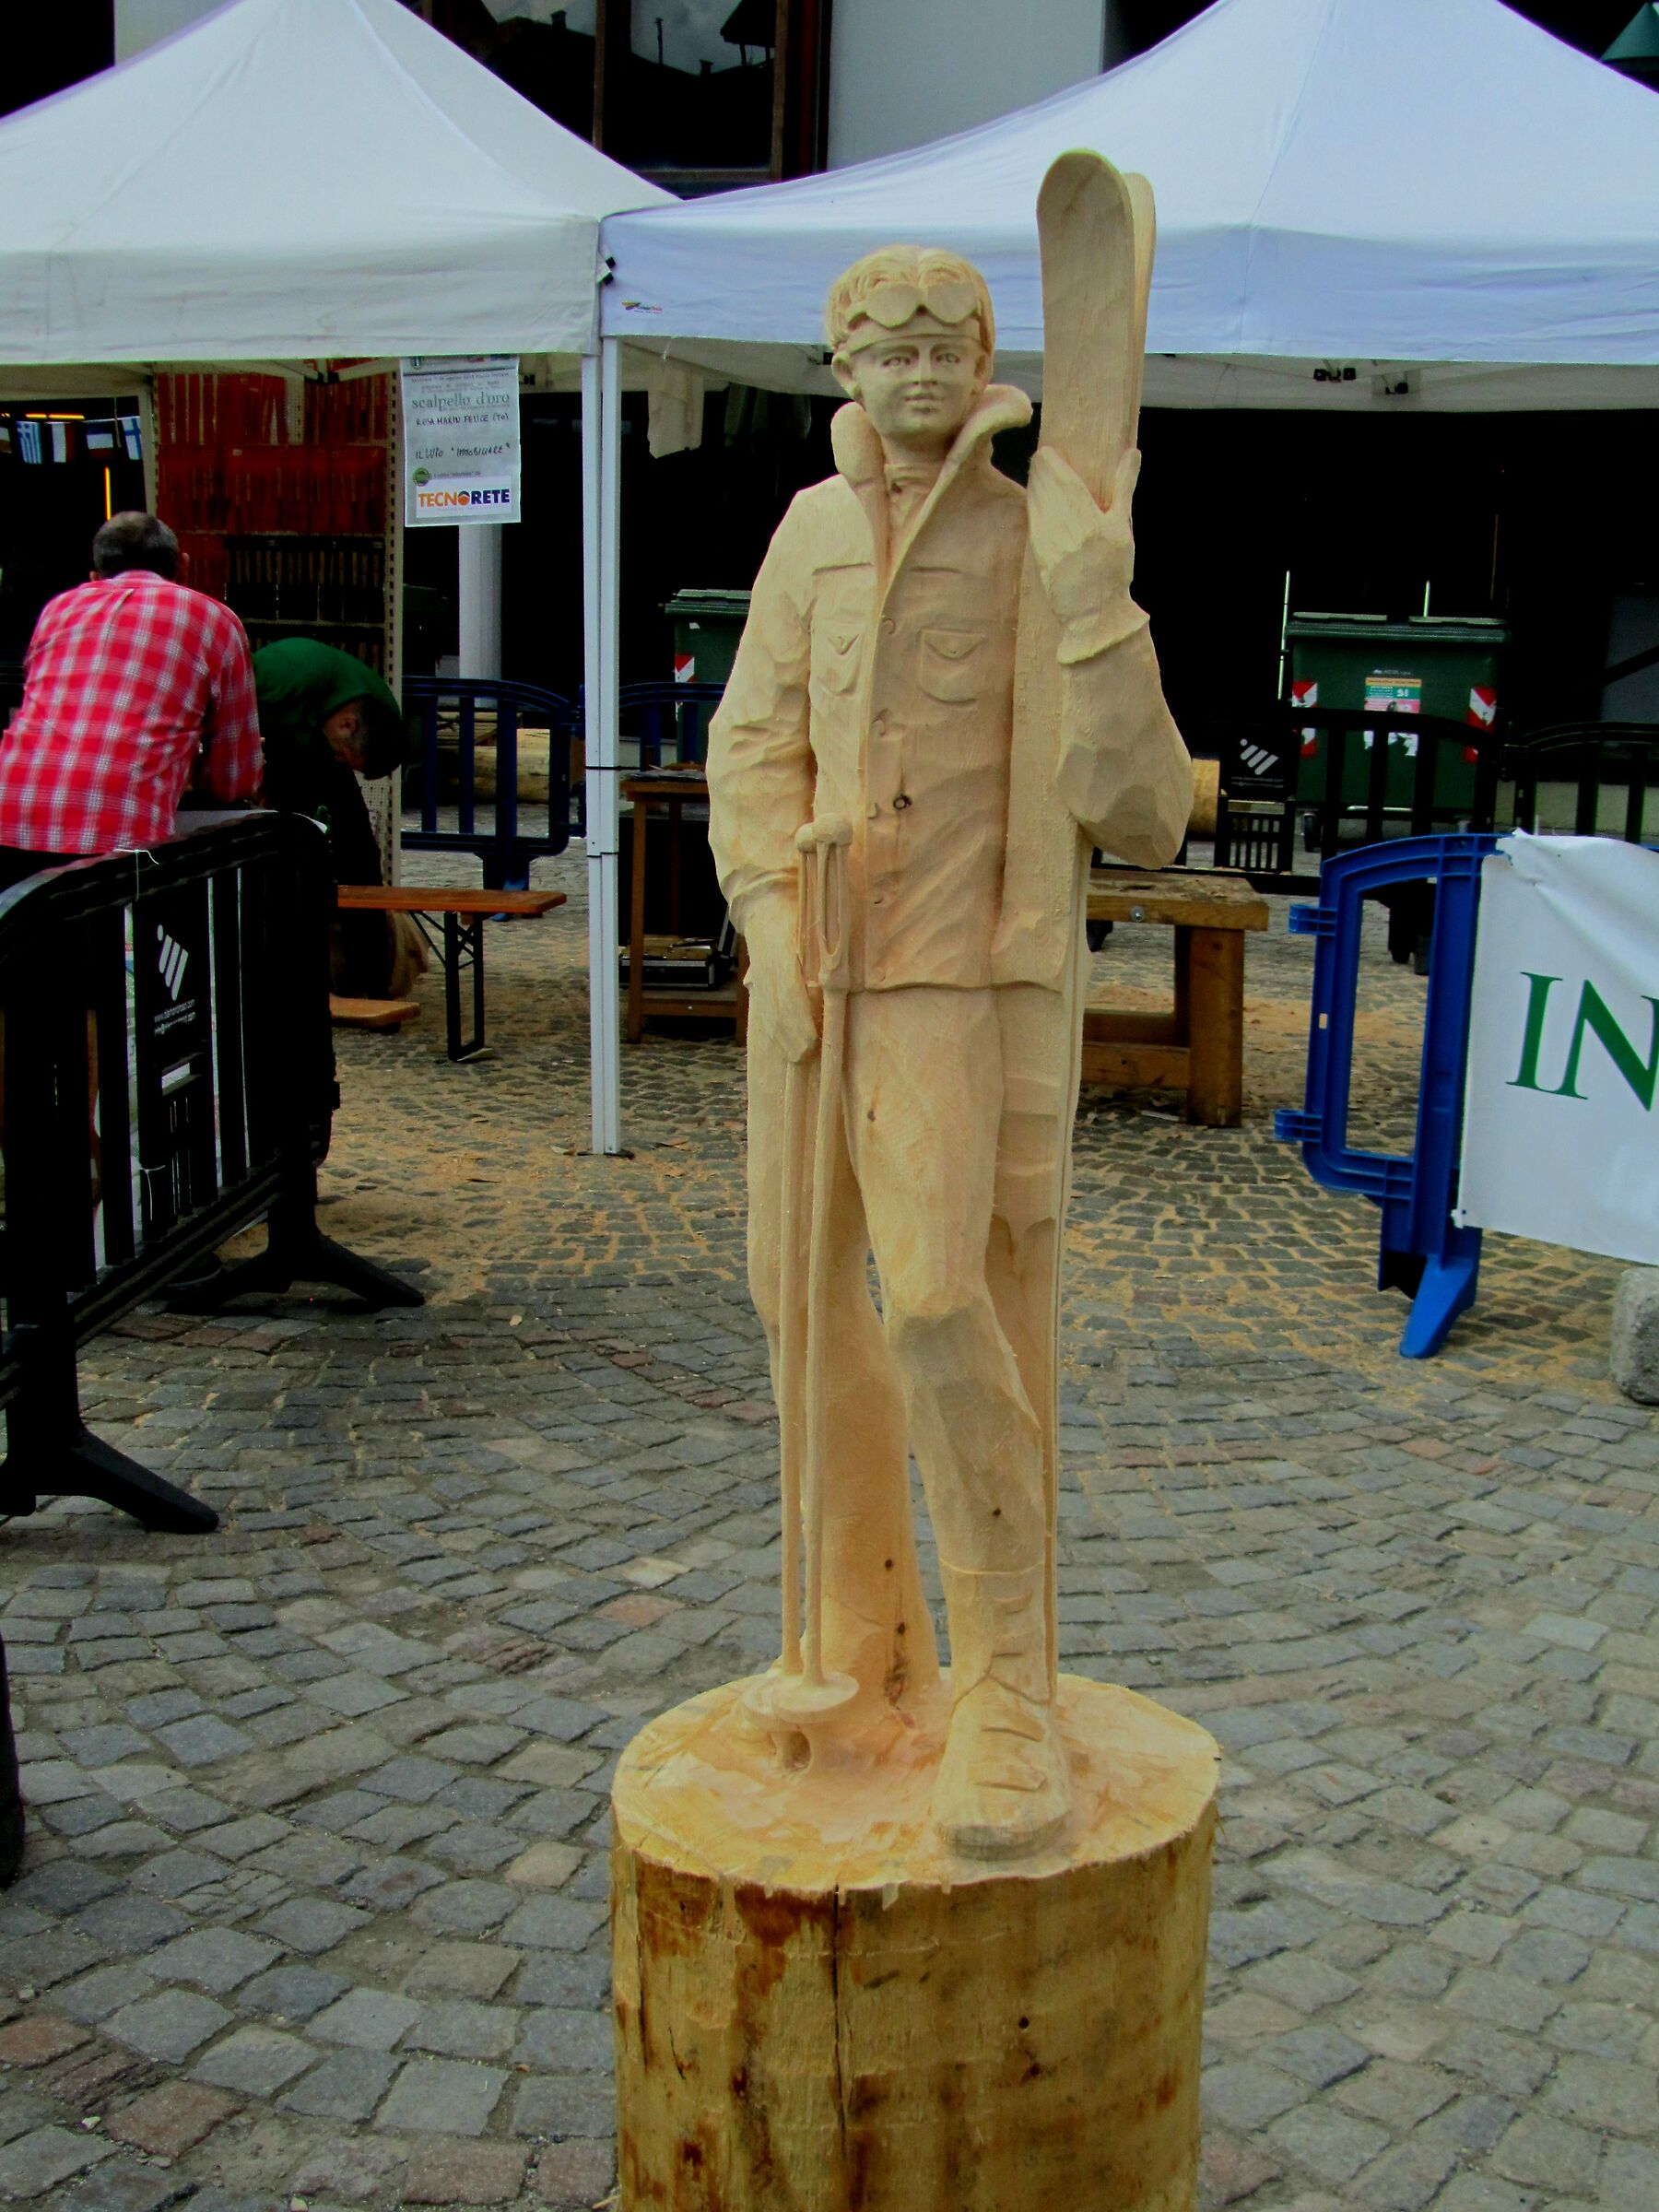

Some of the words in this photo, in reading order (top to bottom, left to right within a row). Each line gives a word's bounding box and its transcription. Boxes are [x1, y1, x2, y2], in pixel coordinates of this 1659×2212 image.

[412, 394, 470, 411] scalpello
[477, 391, 510, 406] d'oro
[418, 488, 510, 508] TECNORETE
[1506, 971, 1659, 1112] IN
